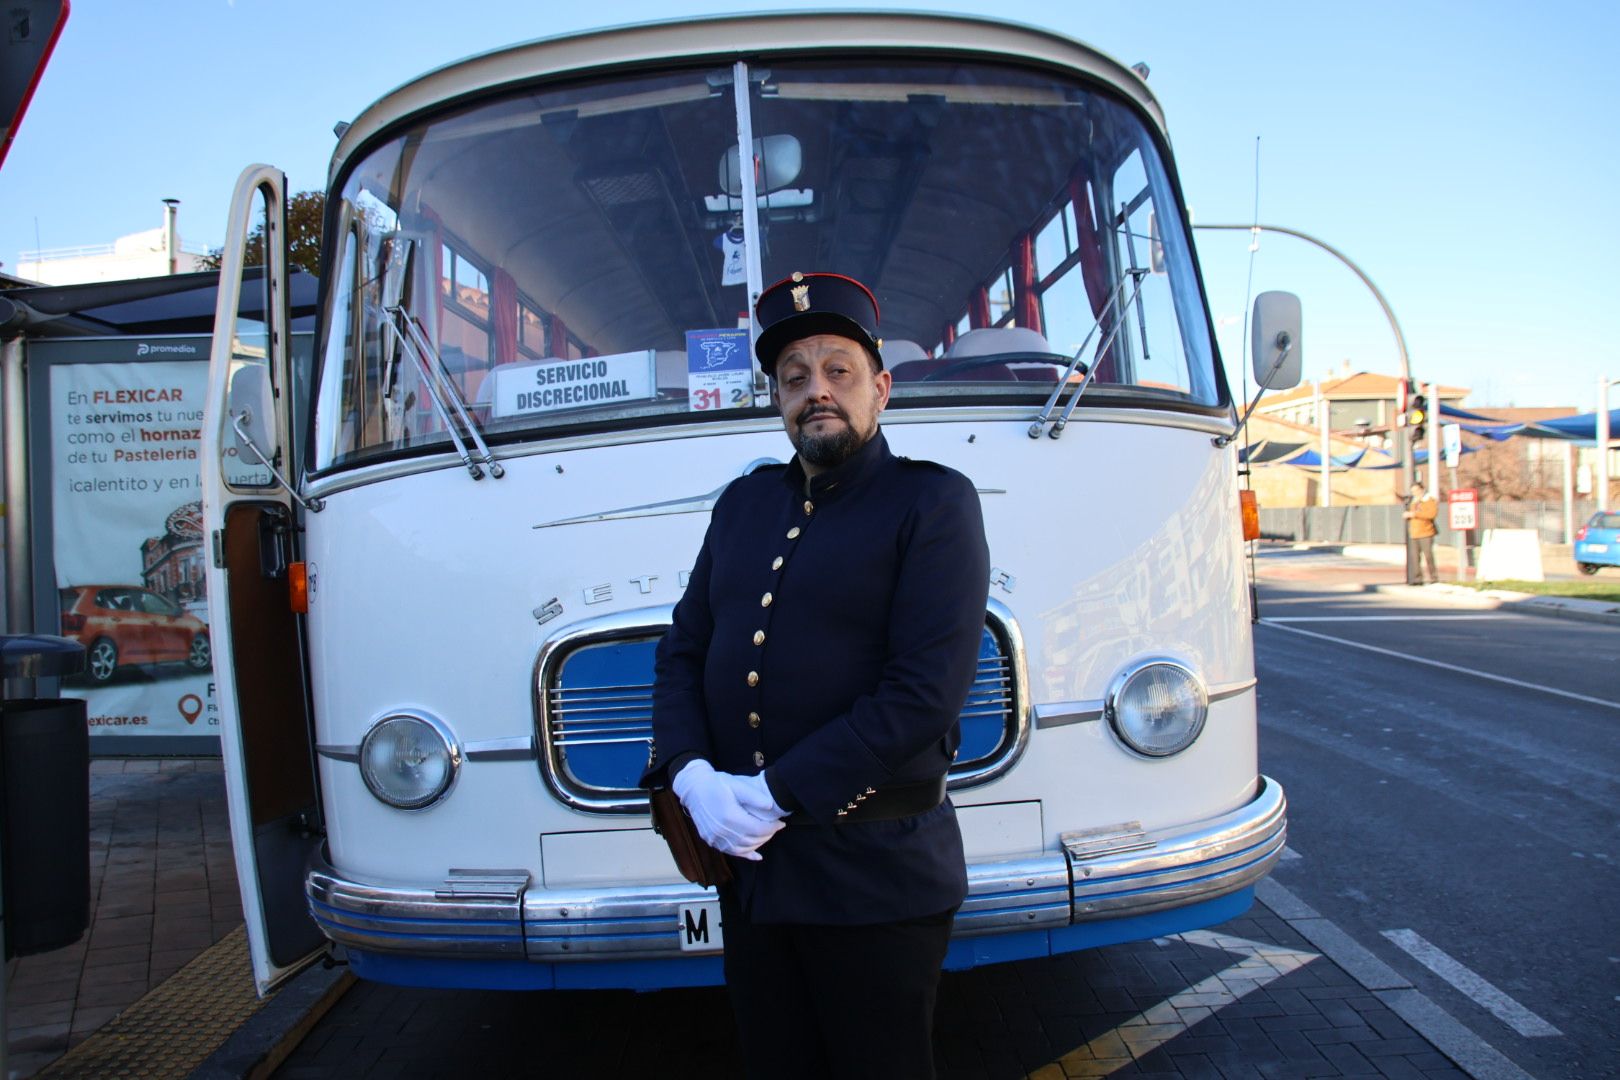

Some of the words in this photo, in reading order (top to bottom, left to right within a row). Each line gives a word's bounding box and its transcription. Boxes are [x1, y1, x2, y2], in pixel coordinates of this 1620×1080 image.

[536, 360, 608, 386] SERVICIO
[68, 391, 88, 405] En
[93, 388, 183, 404] FLEXICAR
[517, 380, 630, 410] DISCRECIONAL
[693, 387, 721, 411] 31
[68, 413, 81, 425] te
[85, 410, 153, 424] servimos
[158, 410, 172, 422] tu
[68, 432, 115, 444] como
[121, 428, 135, 443] el
[68, 451, 87, 464] de
[92, 452, 107, 463] tu
[114, 447, 197, 463] Pastelería
[153, 479, 163, 492] y
[169, 478, 189, 489] en
[685, 908, 709, 945] M
